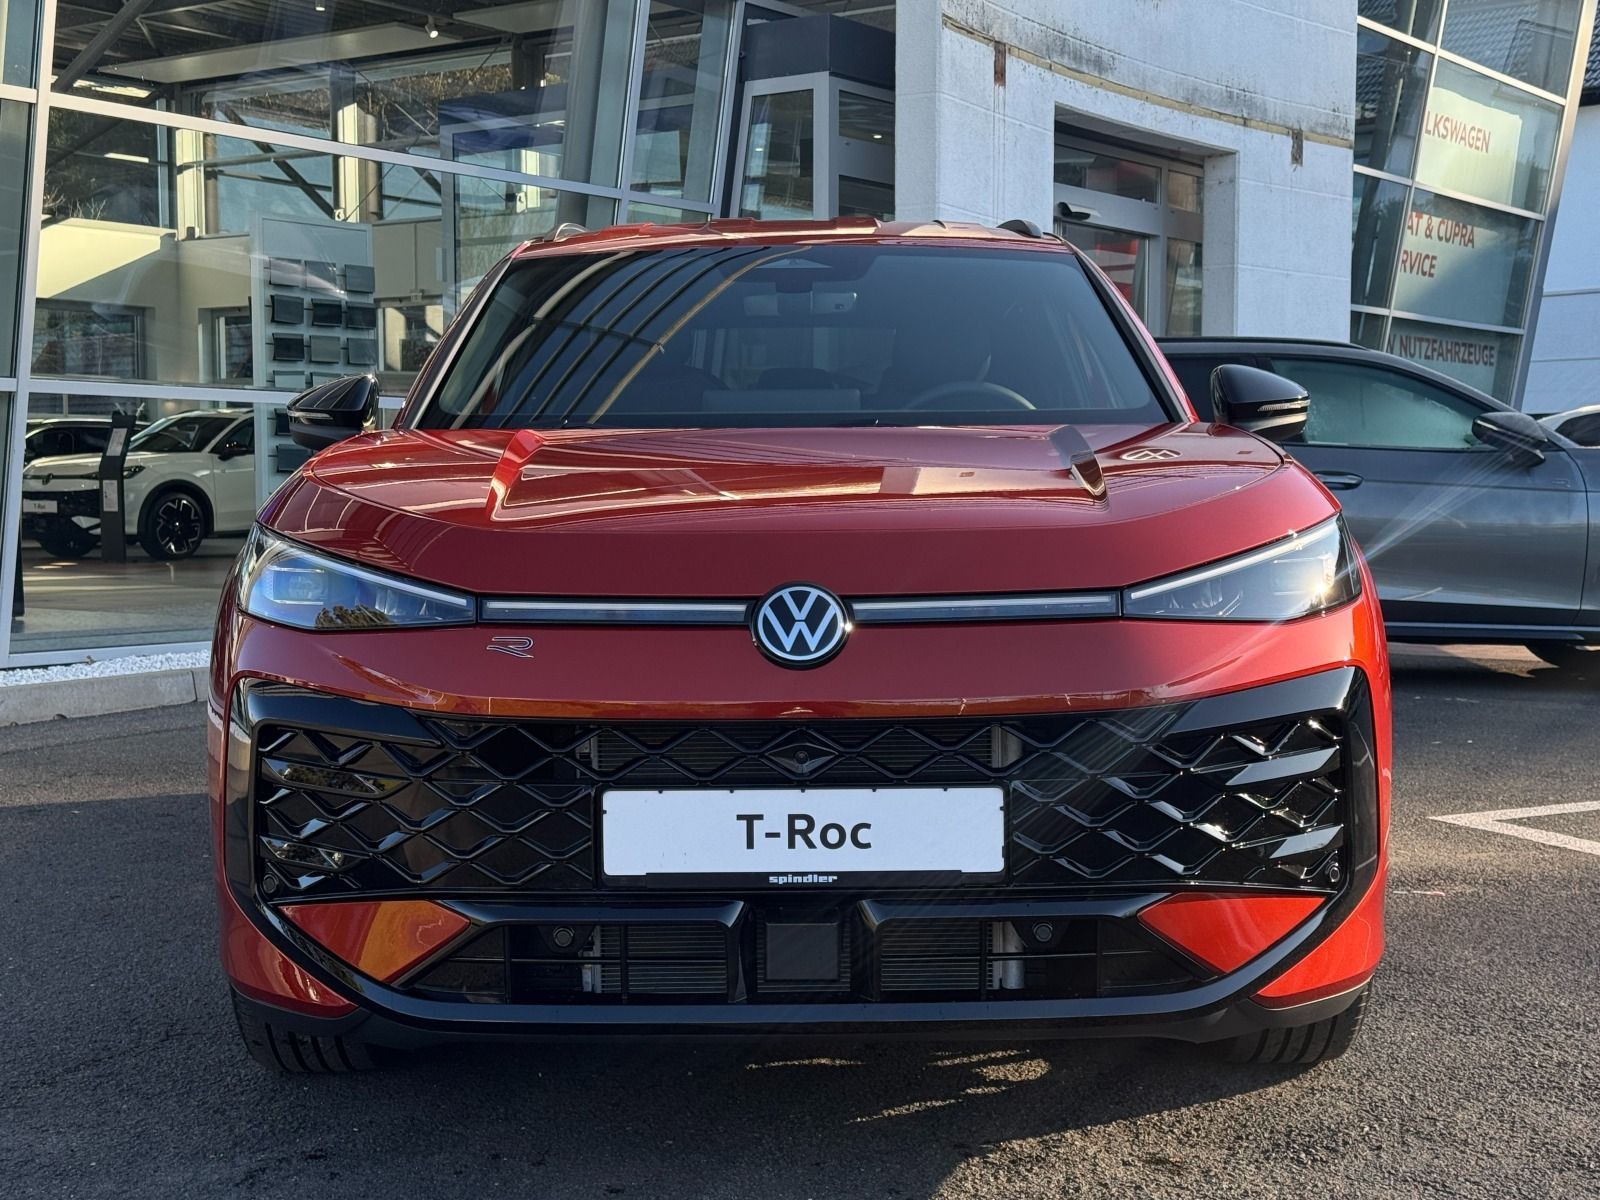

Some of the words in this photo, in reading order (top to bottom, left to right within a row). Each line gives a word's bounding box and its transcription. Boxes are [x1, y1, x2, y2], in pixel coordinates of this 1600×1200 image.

[1425, 215, 1434, 240] &
[1437, 218, 1475, 249] CUPRA
[1400, 335, 1495, 366] NUTZFAHRZEUGE
[736, 813, 872, 850] T-Roc
[768, 874, 838, 885] spindler
